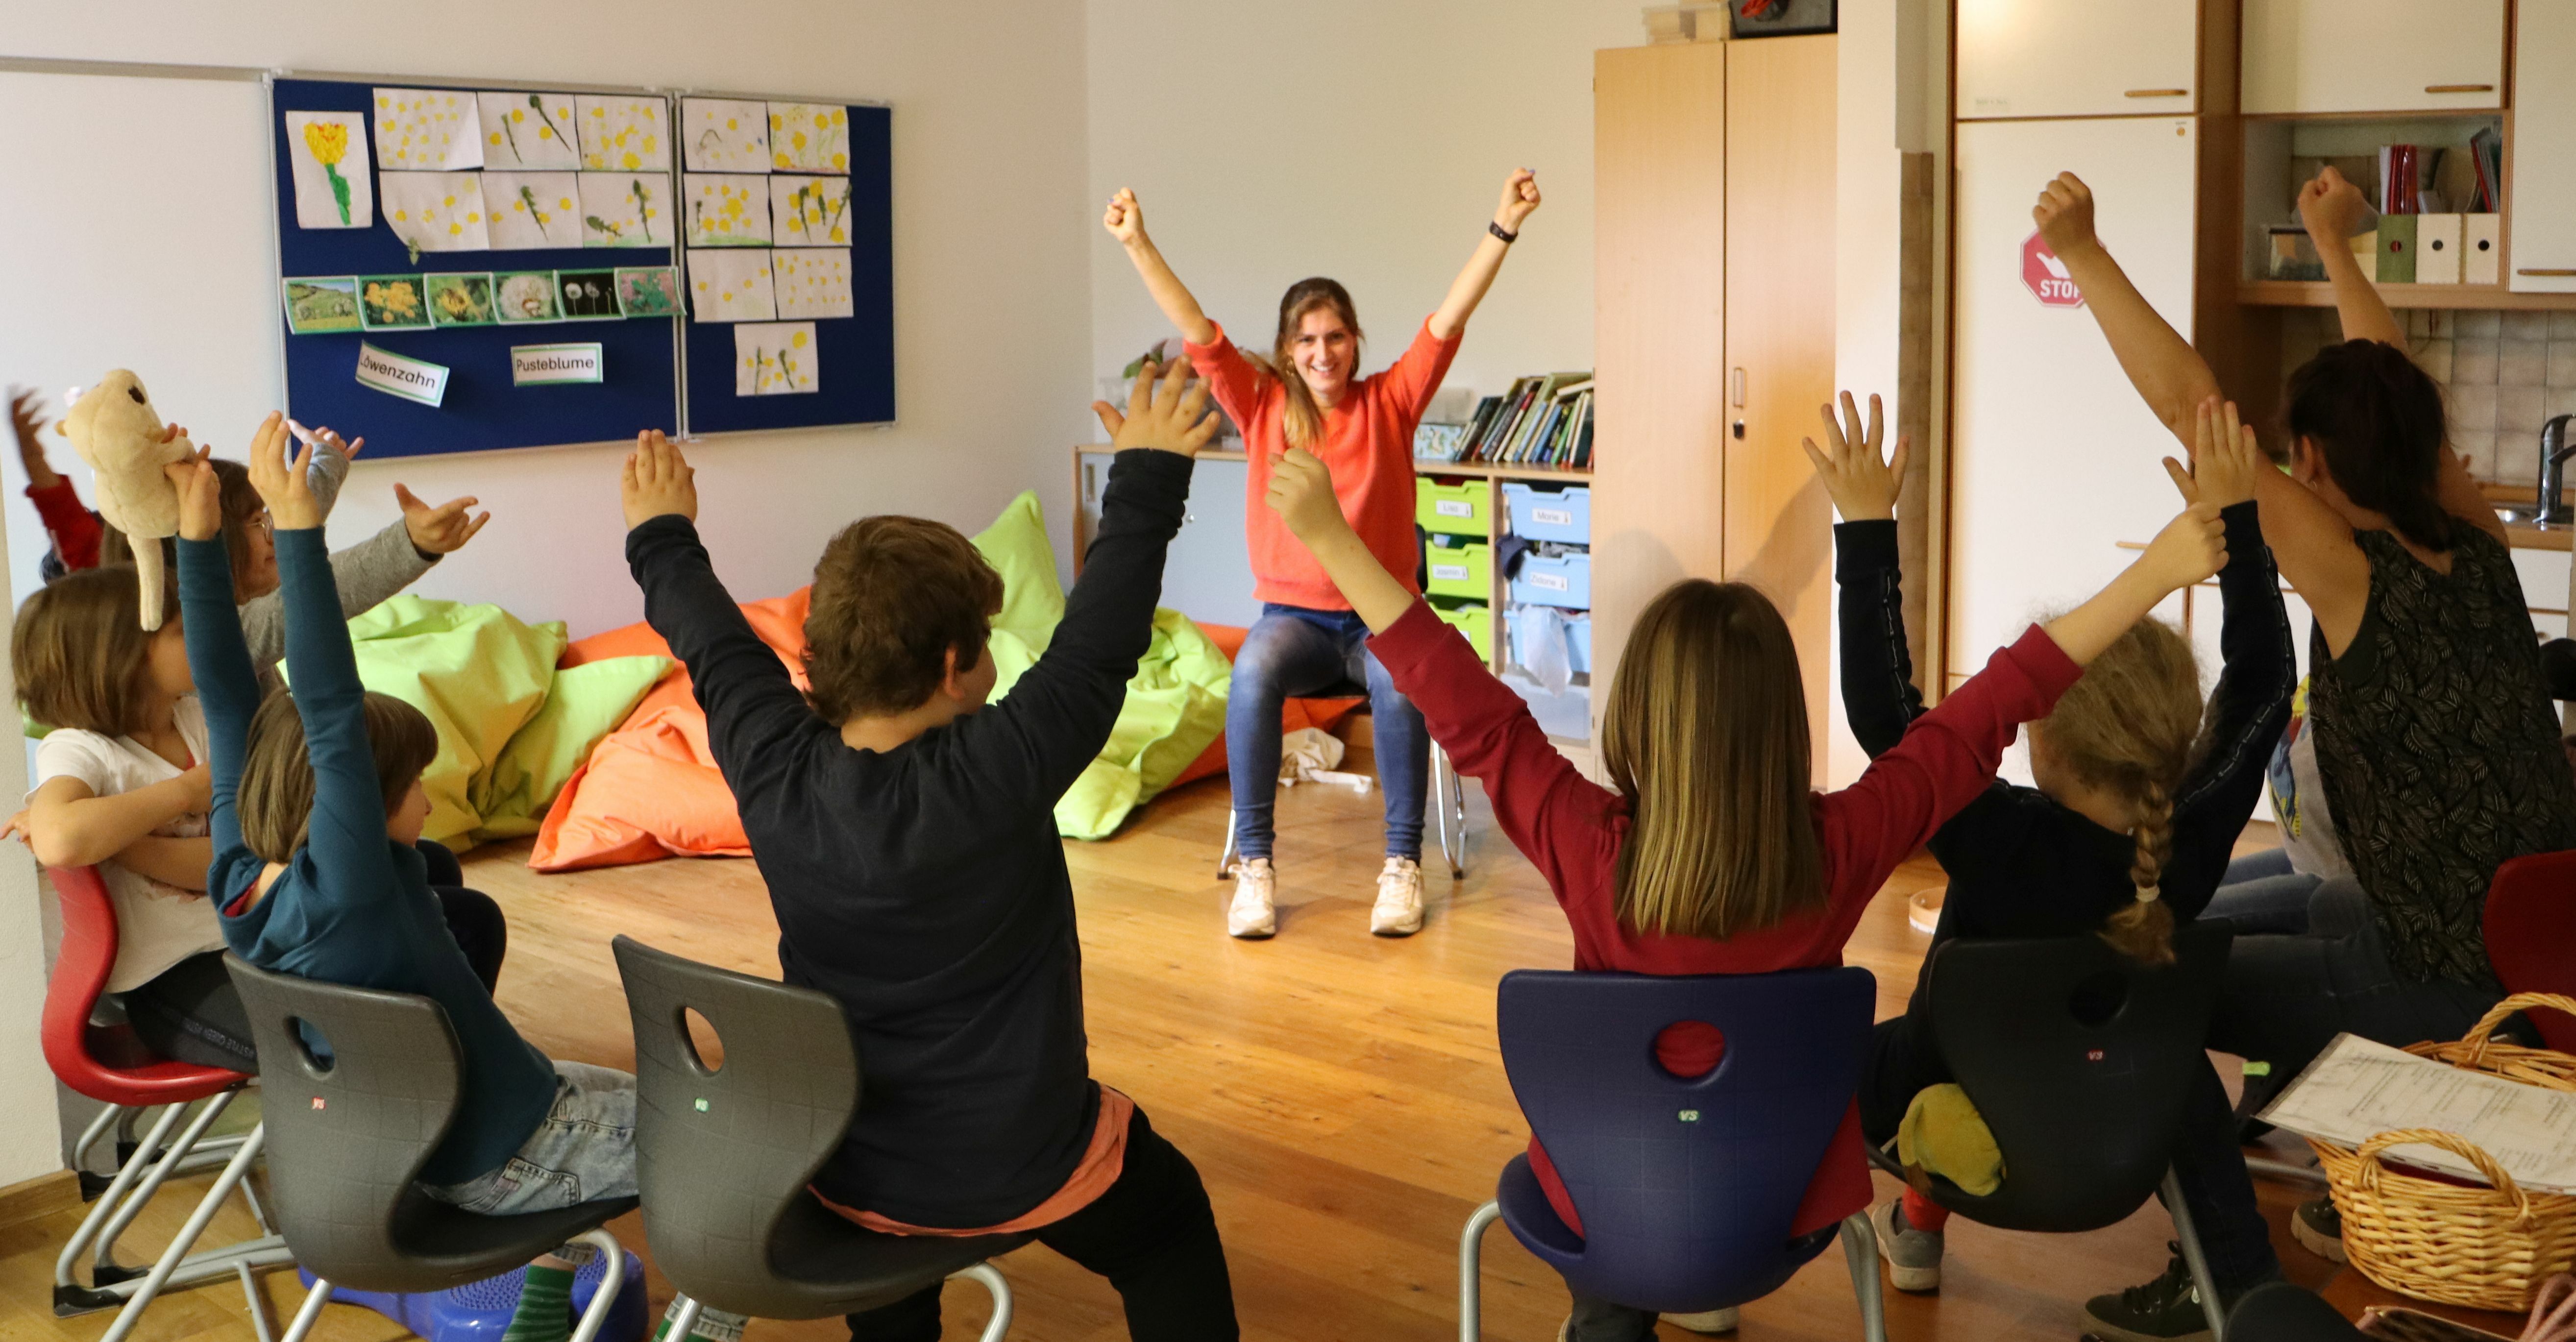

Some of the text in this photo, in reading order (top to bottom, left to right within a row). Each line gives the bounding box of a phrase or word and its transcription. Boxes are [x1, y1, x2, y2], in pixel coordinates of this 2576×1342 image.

[360, 354, 435, 389] Löwenzahn
[516, 357, 594, 372] Pusteblume
[1680, 1110, 1698, 1121] VS
